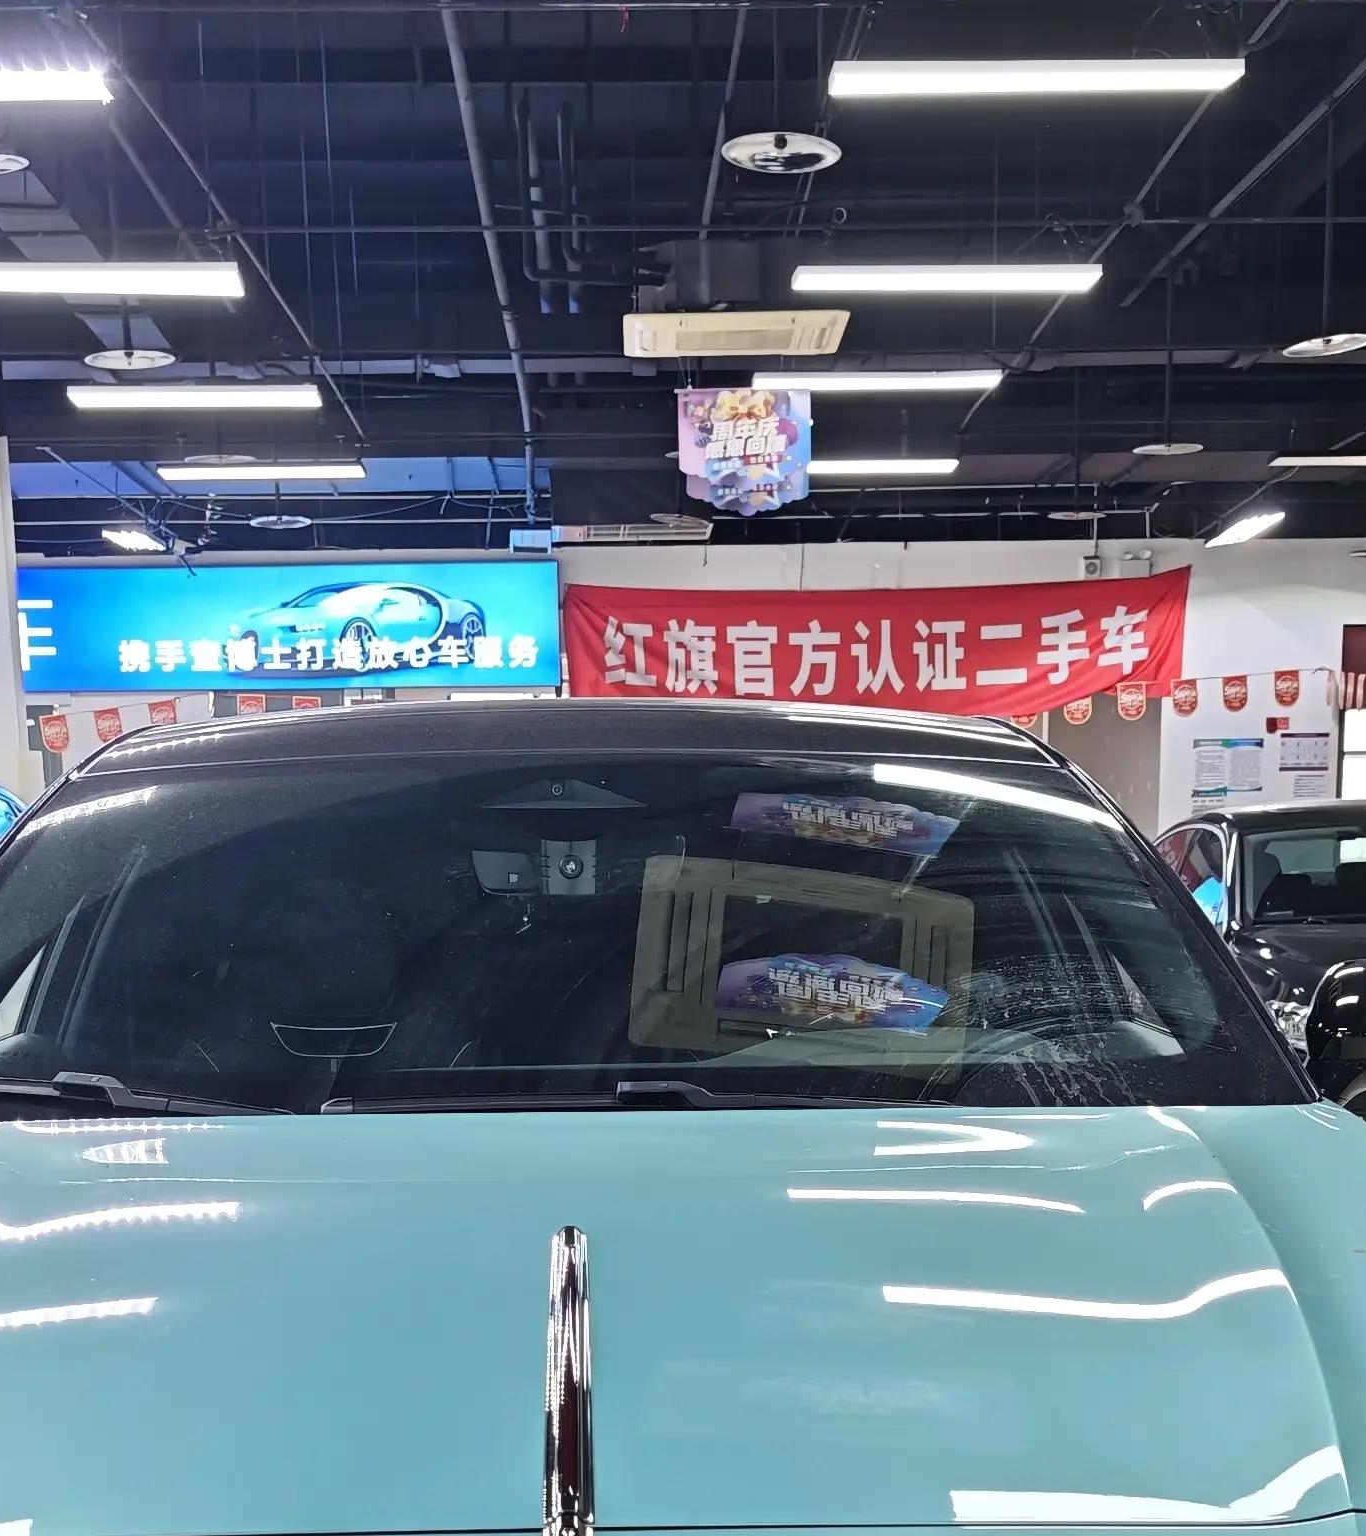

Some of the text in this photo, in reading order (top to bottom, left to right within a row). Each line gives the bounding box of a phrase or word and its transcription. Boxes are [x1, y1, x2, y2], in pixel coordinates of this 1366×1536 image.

[710, 417, 780, 442] 周年庆
[602, 604, 1152, 698] 红旗官方认证二手车
